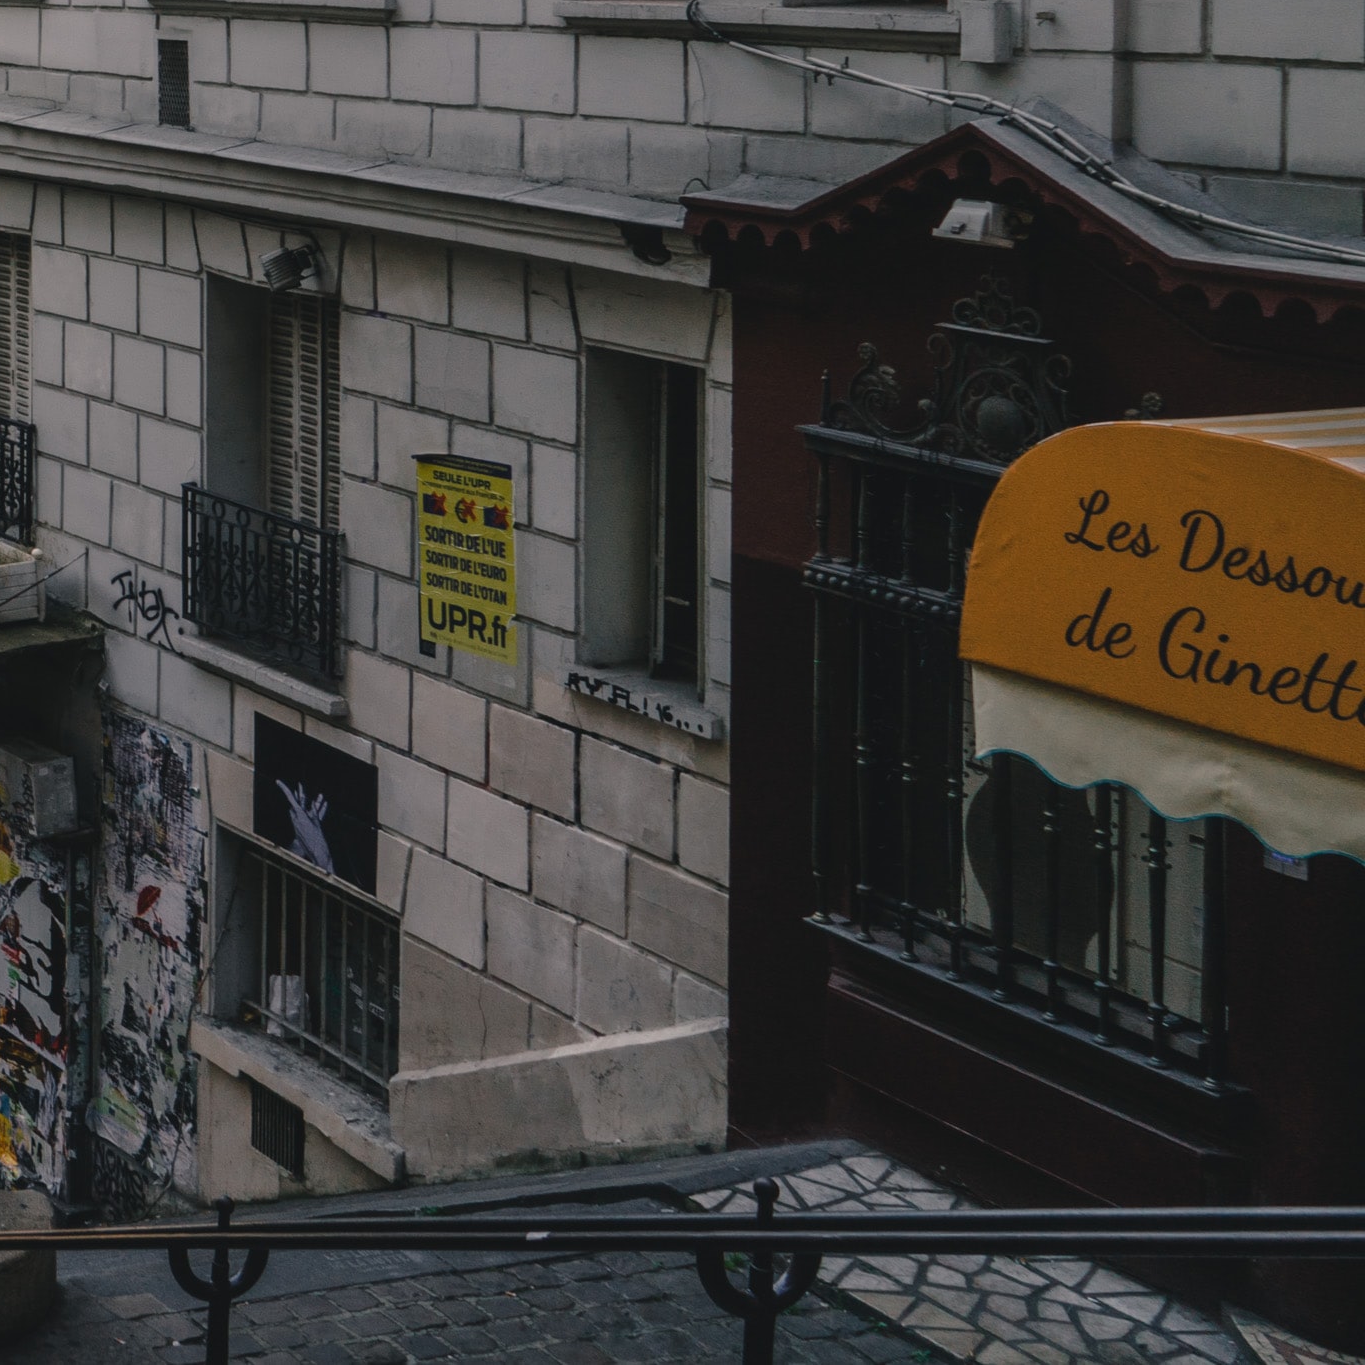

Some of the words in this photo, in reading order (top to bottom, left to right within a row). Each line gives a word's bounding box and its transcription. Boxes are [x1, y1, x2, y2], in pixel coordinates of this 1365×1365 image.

[432, 470, 462, 485] SEULE
[1064, 489, 1160, 559] Les
[425, 525, 464, 548] SORTIR
[466, 534, 480, 554] DE
[482, 537, 506, 559] L'UE
[425, 549, 459, 570] SORTIR
[460, 558, 473, 574] DE
[473, 560, 507, 582] L'EURO
[426, 572, 460, 593] SORTIR
[460, 580, 473, 597] DE
[474, 584, 508, 606] L'OTAN
[427, 597, 508, 649] UPR.fr
[1064, 586, 1138, 660] de
